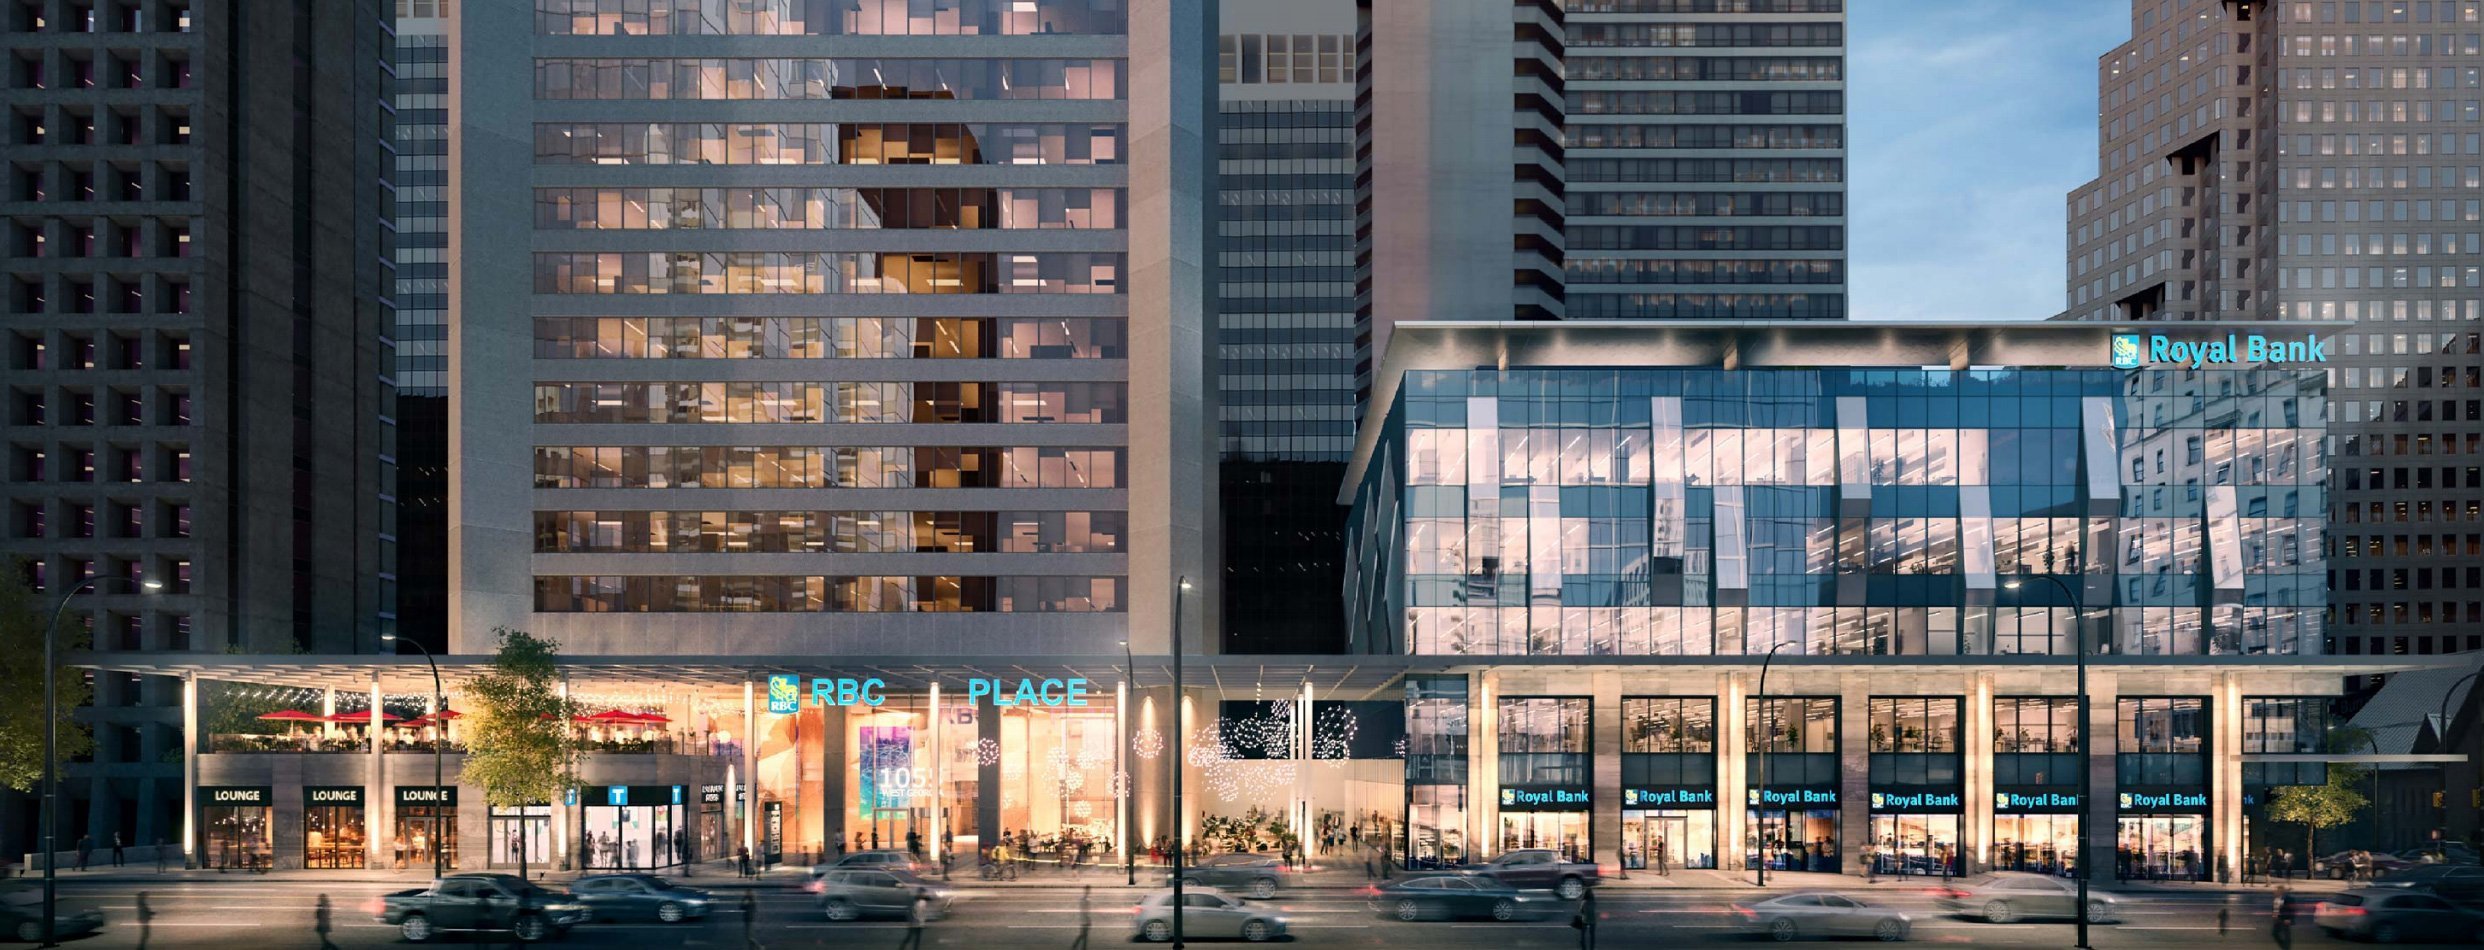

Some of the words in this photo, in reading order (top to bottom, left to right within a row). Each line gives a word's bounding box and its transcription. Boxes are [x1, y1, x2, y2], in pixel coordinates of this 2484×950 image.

[2150, 333, 2238, 370] Royal
[2247, 334, 2327, 362] Bank
[811, 678, 886, 706] RBC
[968, 678, 1088, 706] PLACE
[771, 701, 797, 711] RBC
[215, 790, 260, 801] LOUNGE
[312, 790, 357, 801] LOUNGE
[612, 789, 624, 804] T
[673, 787, 680, 803] T
[1516, 789, 1554, 806] Royal
[1556, 789, 1589, 803] Bank
[1639, 789, 1677, 806] Royal
[1679, 789, 1713, 803] Bank
[1763, 789, 1800, 806] Royal
[1803, 789, 1836, 803] Bank
[1886, 793, 1922, 809] Royal
[1925, 793, 1959, 806] Bank
[2010, 793, 2048, 809] Royal
[2134, 793, 2171, 809] Royal
[2173, 793, 2207, 806] Bank
